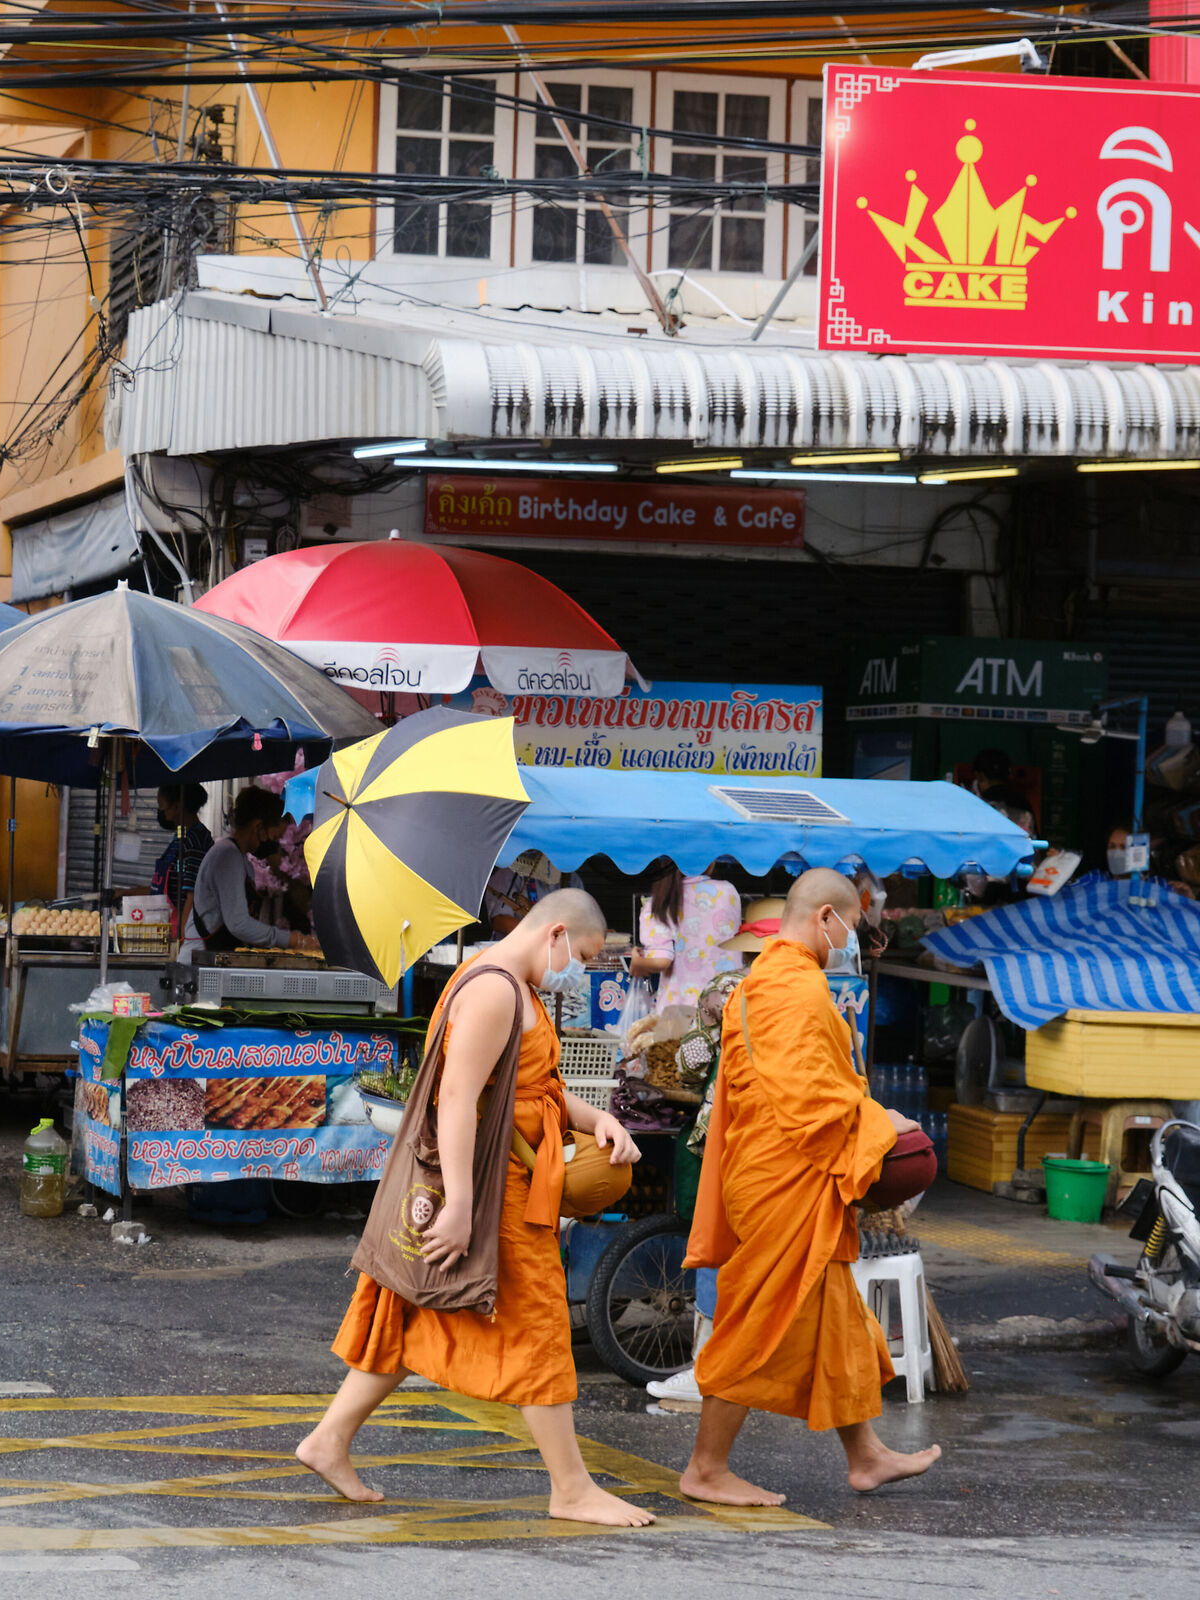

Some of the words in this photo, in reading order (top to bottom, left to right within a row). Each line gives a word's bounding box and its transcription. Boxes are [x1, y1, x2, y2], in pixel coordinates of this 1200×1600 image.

[1096, 125, 1200, 272] คิ
[902, 270, 1028, 302] CAKE
[438, 484, 512, 516] คิงเค้ก
[517, 495, 628, 530] Birthday
[637, 500, 697, 525] Cake
[713, 505, 728, 527] &
[737, 504, 797, 530] Cafe
[20, 665, 29, 676] 1
[859, 657, 898, 696] ATM
[955, 657, 1043, 697] ATM
[0, 702, 15, 713] 3
[8, 684, 23, 696] 2
[511, 687, 820, 745] ขาวเหนยวหมูเลิศรส
[534, 732, 612, 767] หม-เนื้อ
[621, 741, 716, 770] แดดเดียว
[129, 1030, 394, 1077] หมูปิ้งนมสดน้องใบบัว
[131, 1131, 316, 1161] หอมอร่อยสะอาด
